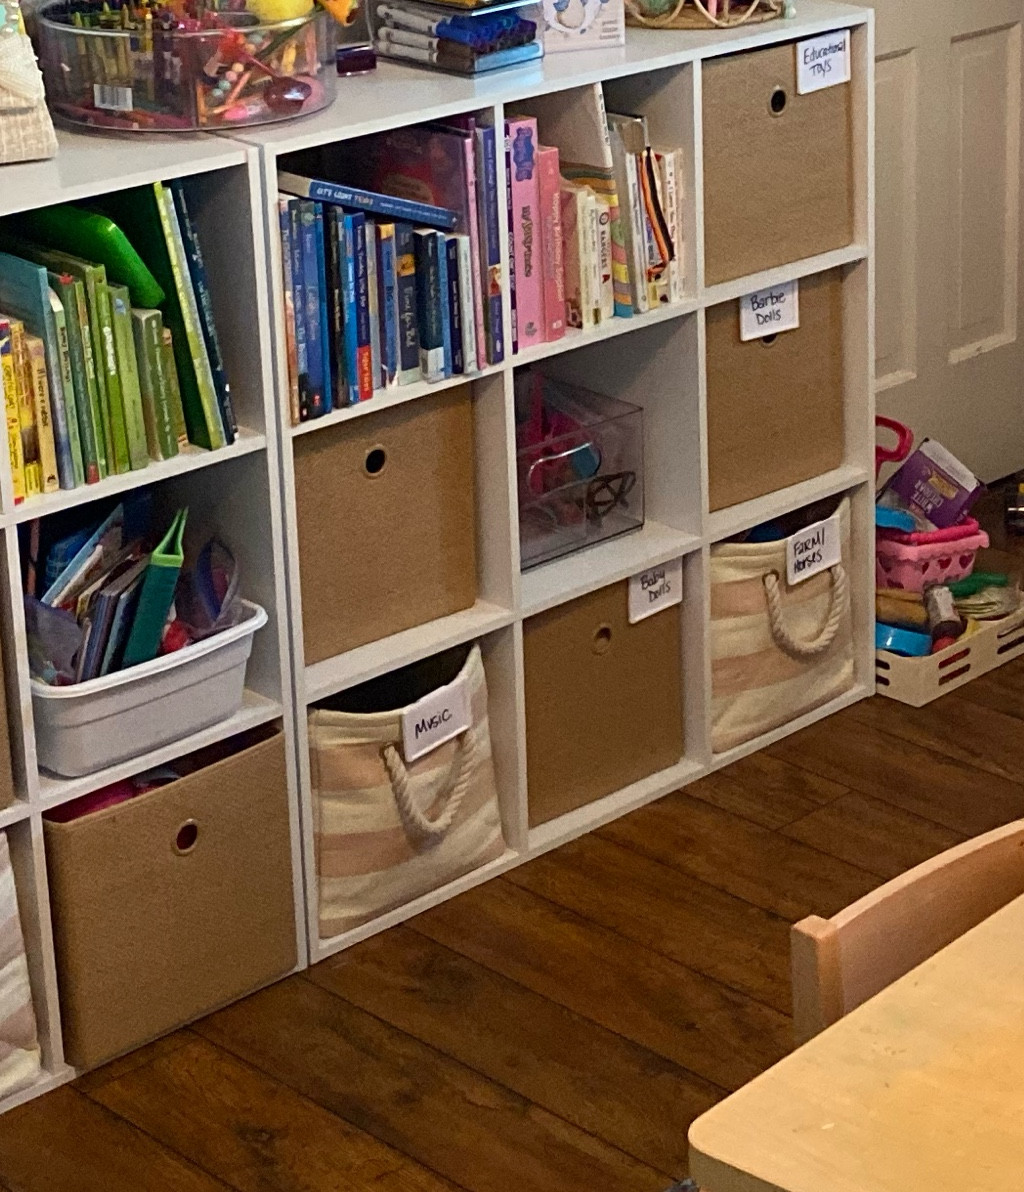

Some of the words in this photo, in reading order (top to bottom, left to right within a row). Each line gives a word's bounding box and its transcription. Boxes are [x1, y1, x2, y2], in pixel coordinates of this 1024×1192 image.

[549, 192, 560, 223] Happy
[402, 286, 414, 310] Time
[750, 291, 786, 311] Barbie
[401, 311, 413, 327] for
[756, 309, 781, 325] Dolls
[404, 328, 416, 347] Bed
[648, 581, 671, 602] Dolls
